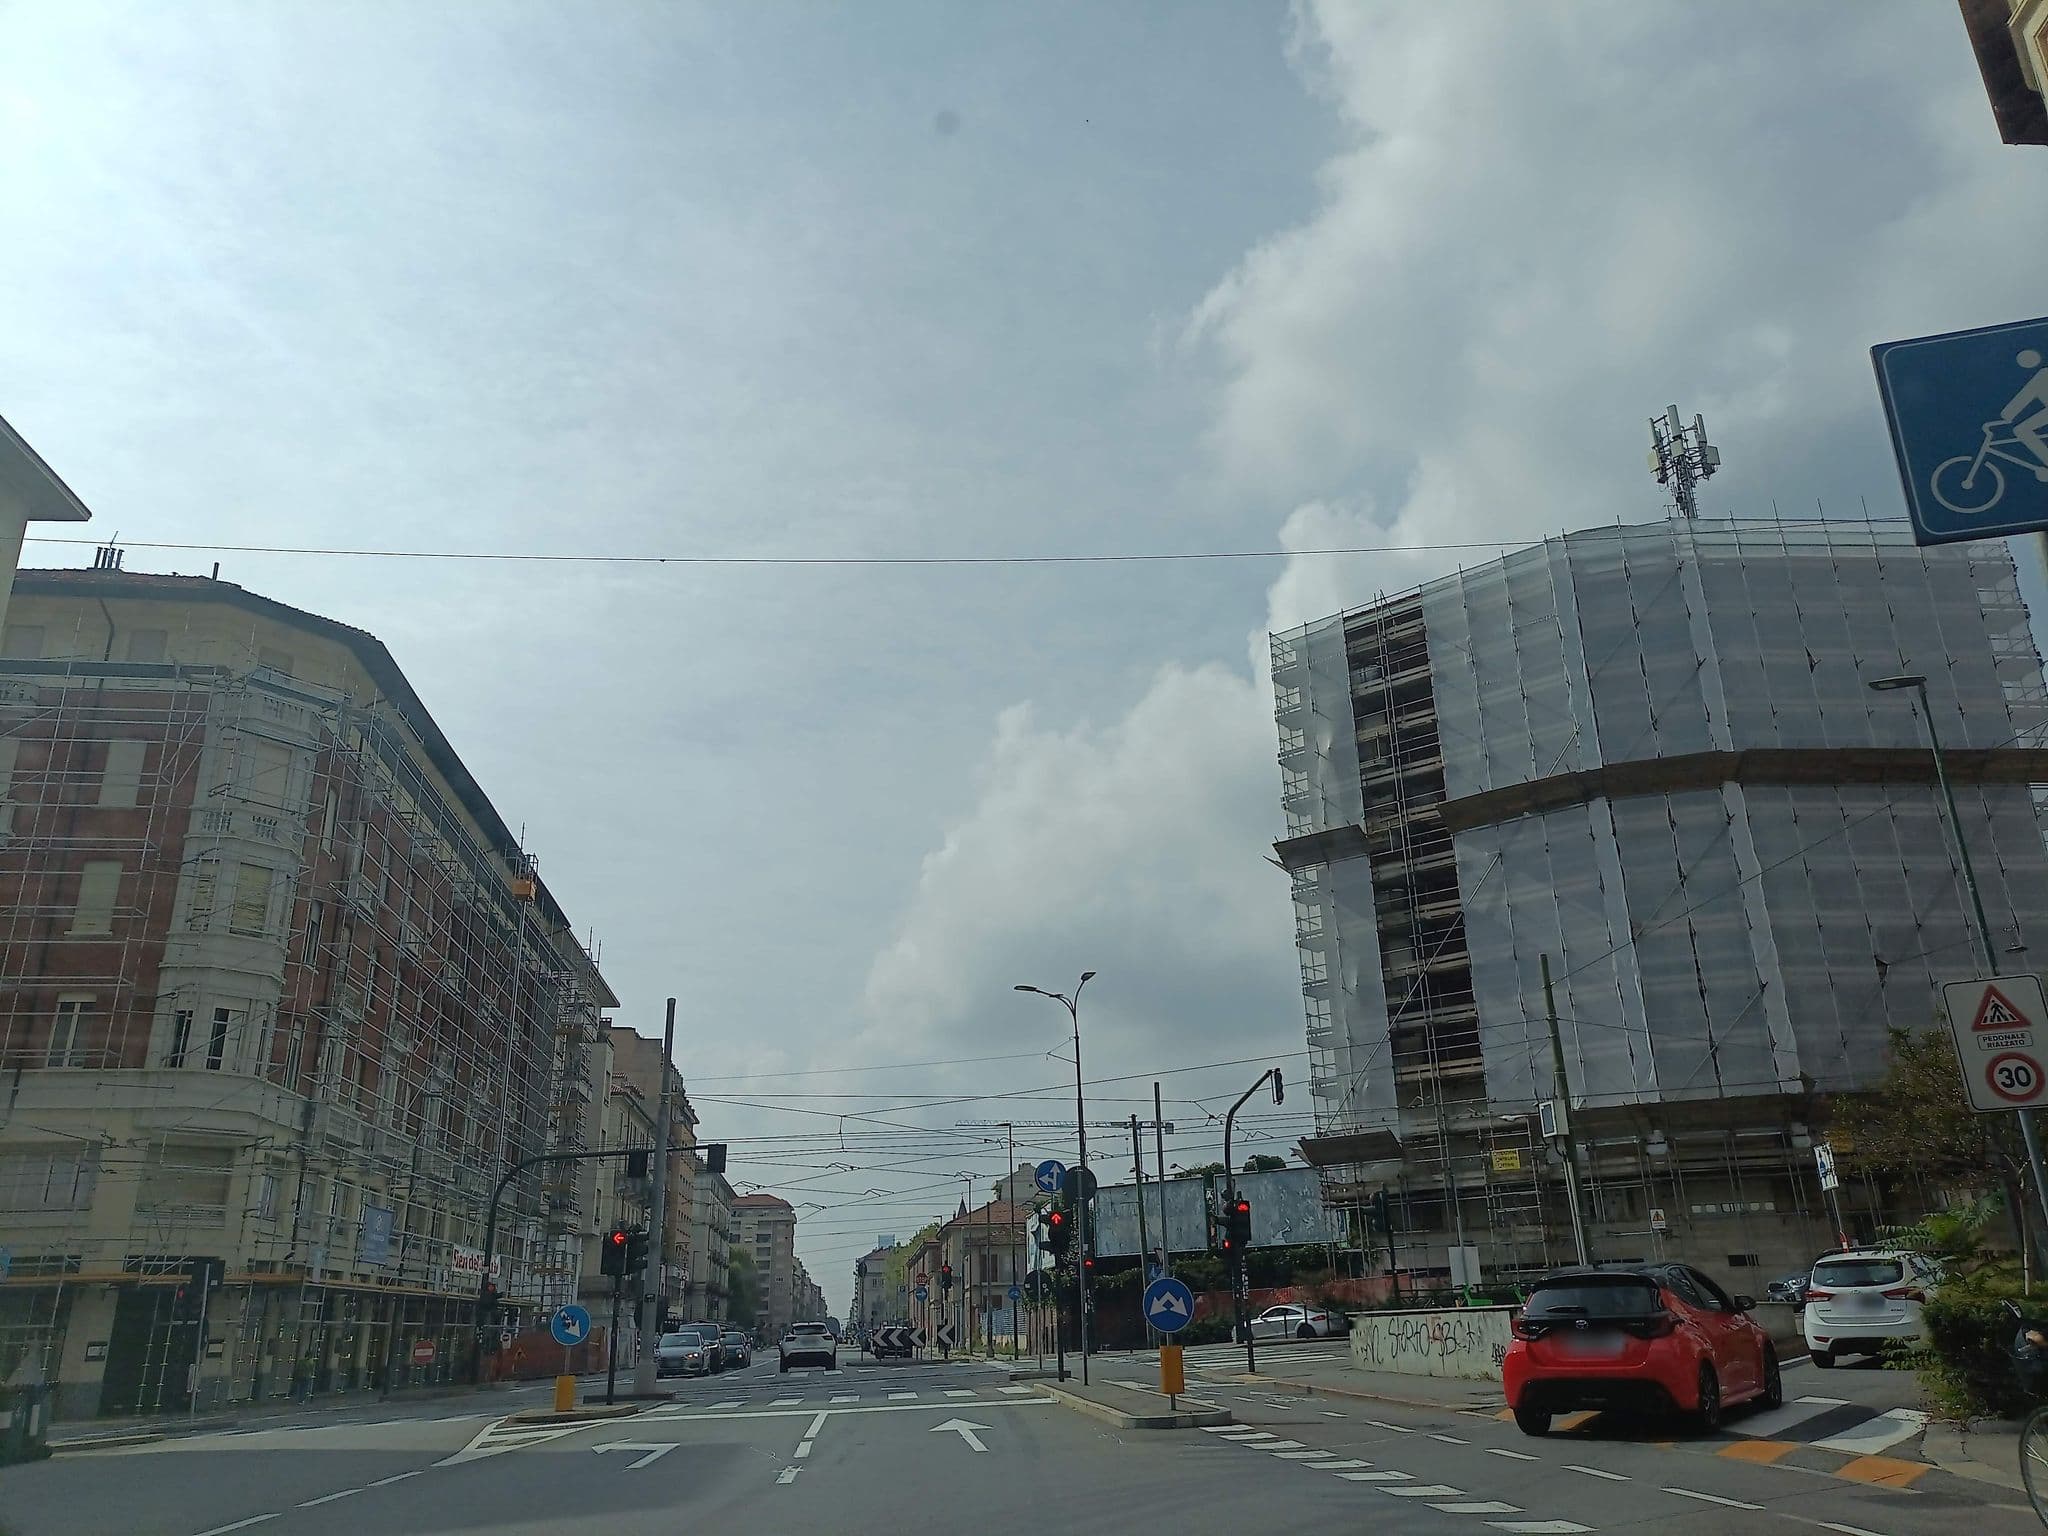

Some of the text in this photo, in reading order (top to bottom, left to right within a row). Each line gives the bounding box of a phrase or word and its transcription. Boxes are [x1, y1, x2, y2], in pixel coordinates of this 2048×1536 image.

[1982, 1033, 2026, 1043] PEDONALE
[1986, 1040, 2026, 1049] RIALZATO
[1998, 1066, 2032, 1089] 30
